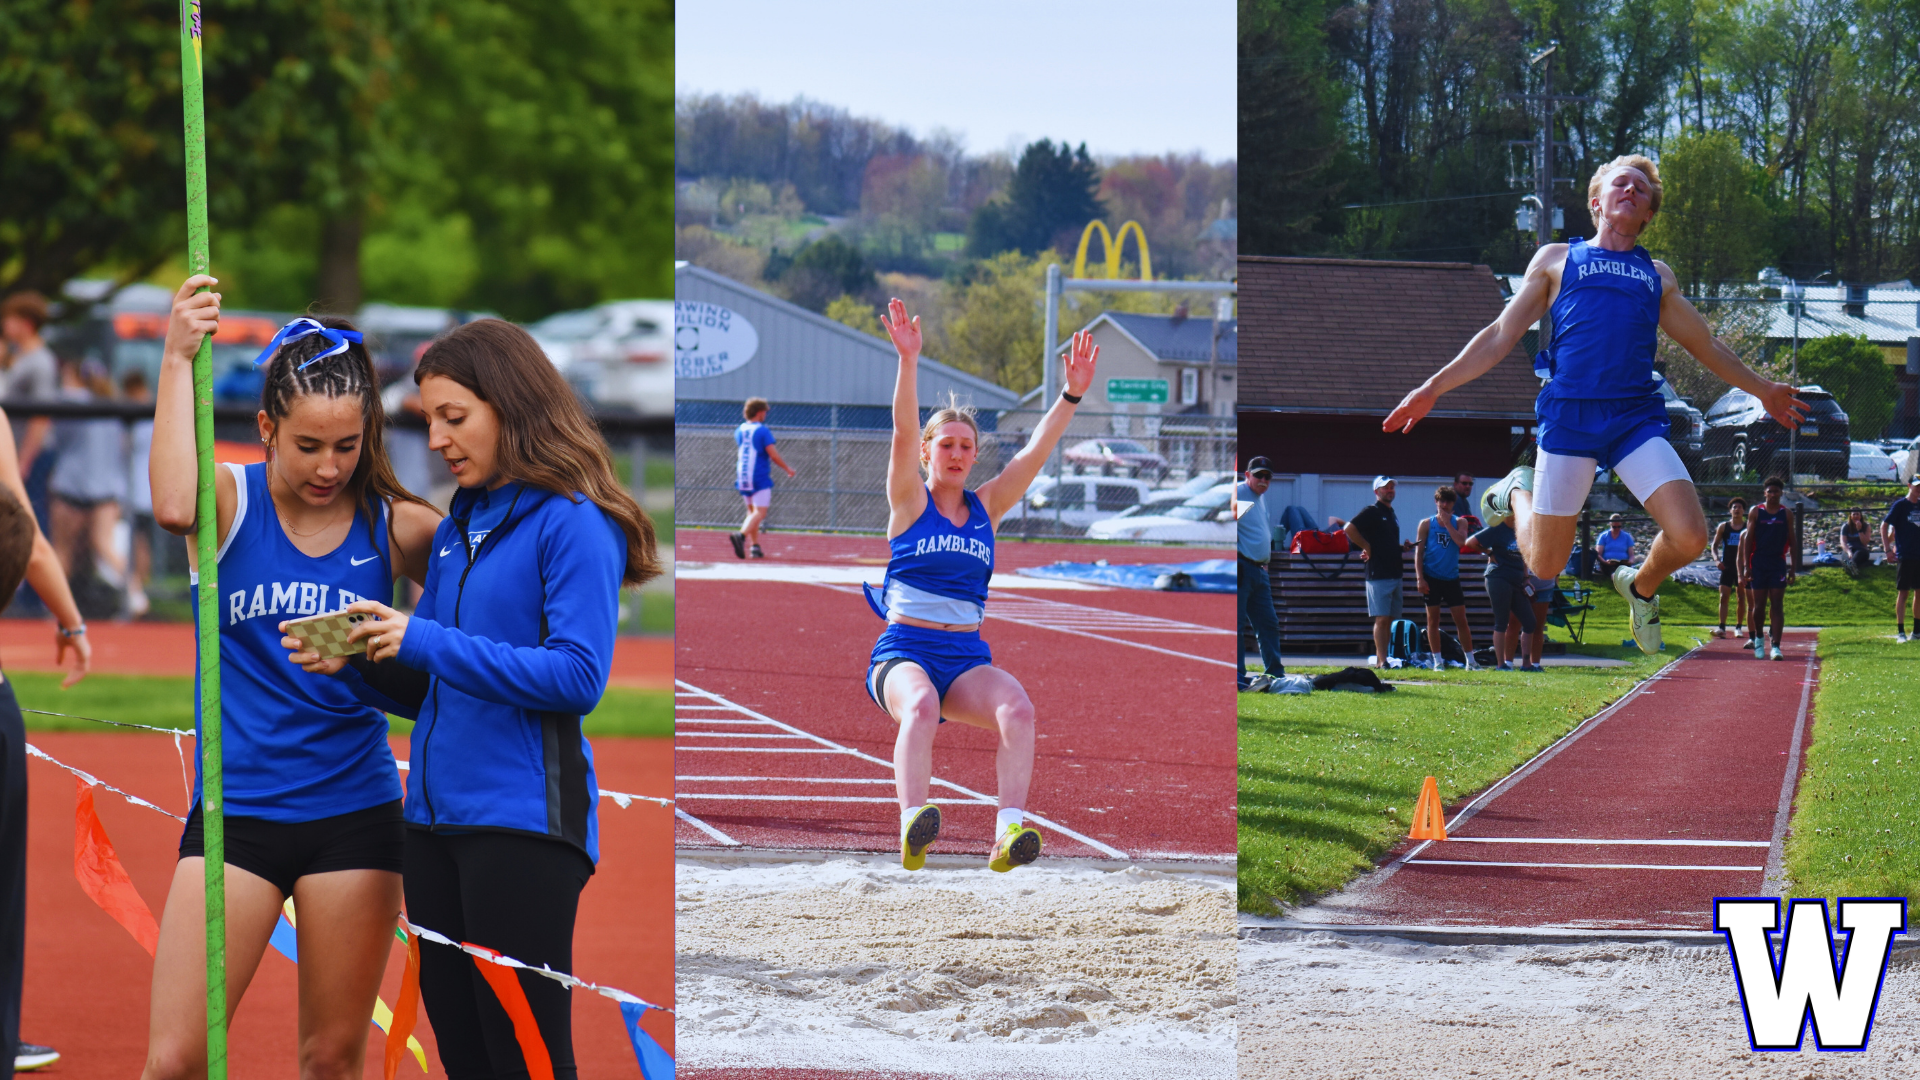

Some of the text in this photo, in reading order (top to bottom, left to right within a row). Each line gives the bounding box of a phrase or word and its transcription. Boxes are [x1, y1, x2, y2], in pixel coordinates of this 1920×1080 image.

[1578, 261, 1655, 293] RAMBLERS
[914, 534, 991, 566] RAMBLERS
[229, 581, 370, 626] RAMBLE
